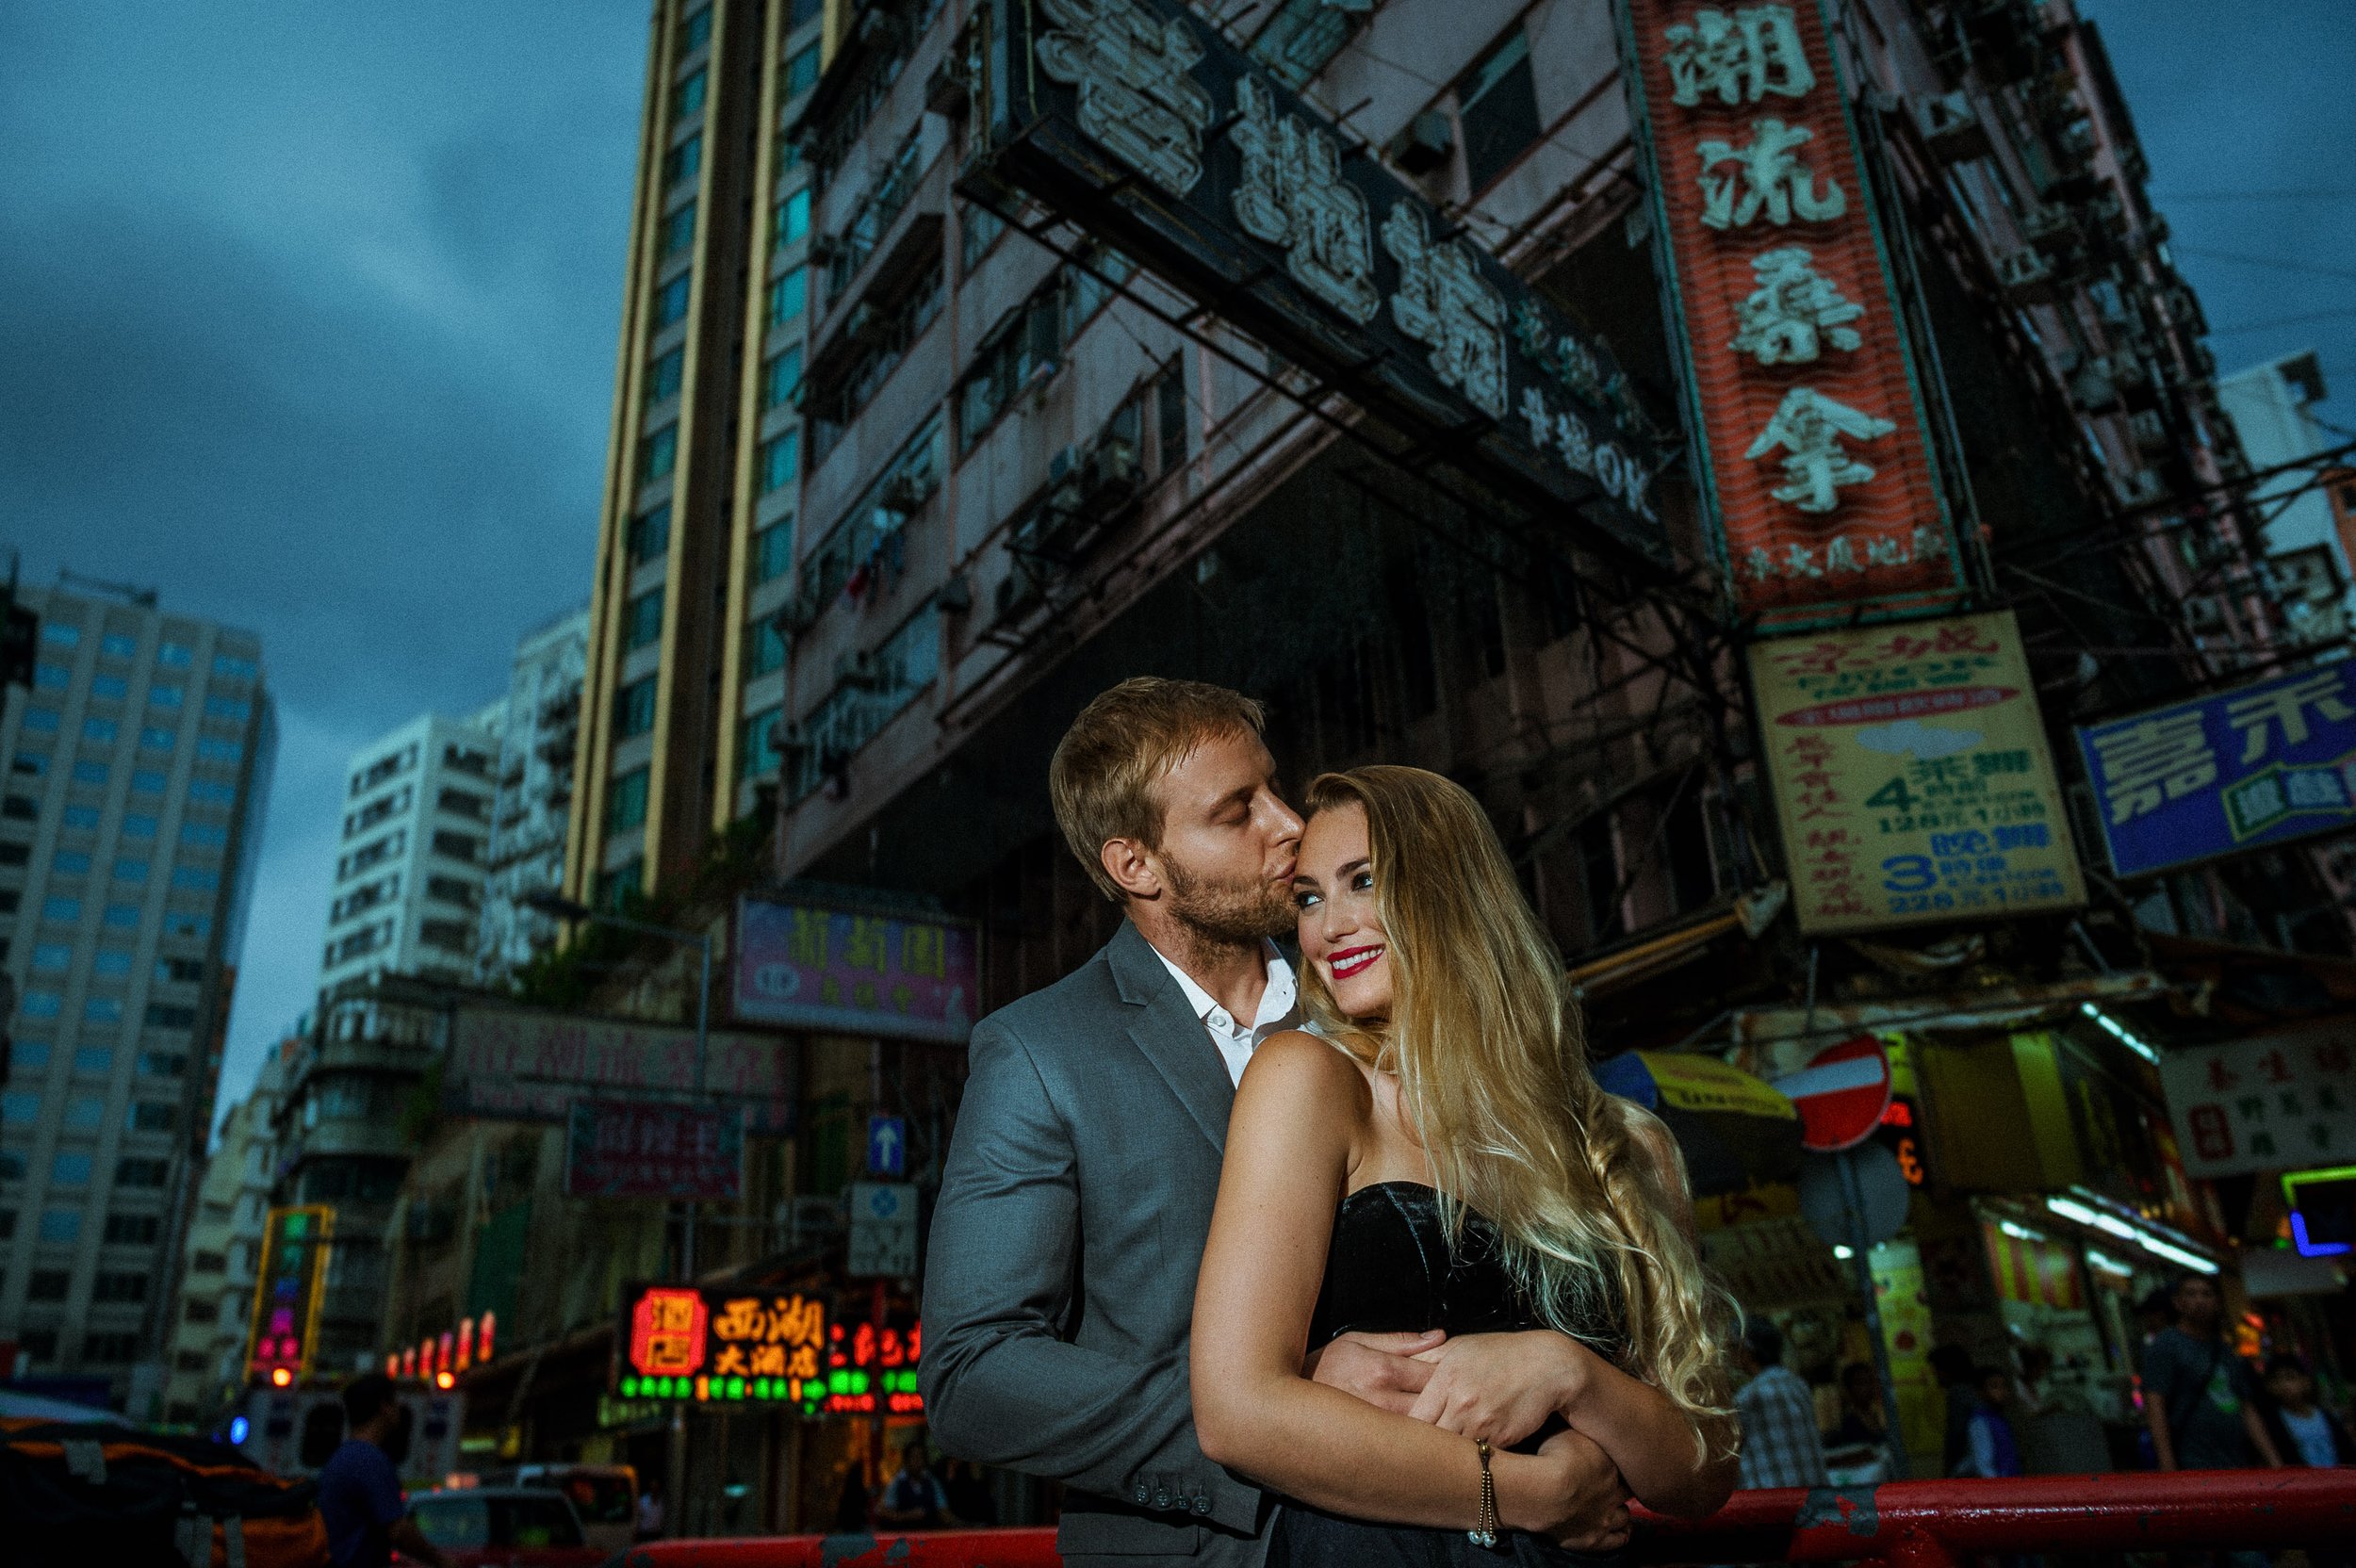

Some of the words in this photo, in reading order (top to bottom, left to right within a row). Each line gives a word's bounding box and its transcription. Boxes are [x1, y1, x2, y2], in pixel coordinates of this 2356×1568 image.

[1661, 5, 1897, 513] 潮流桑拿
[1881, 854, 1937, 892] 3
